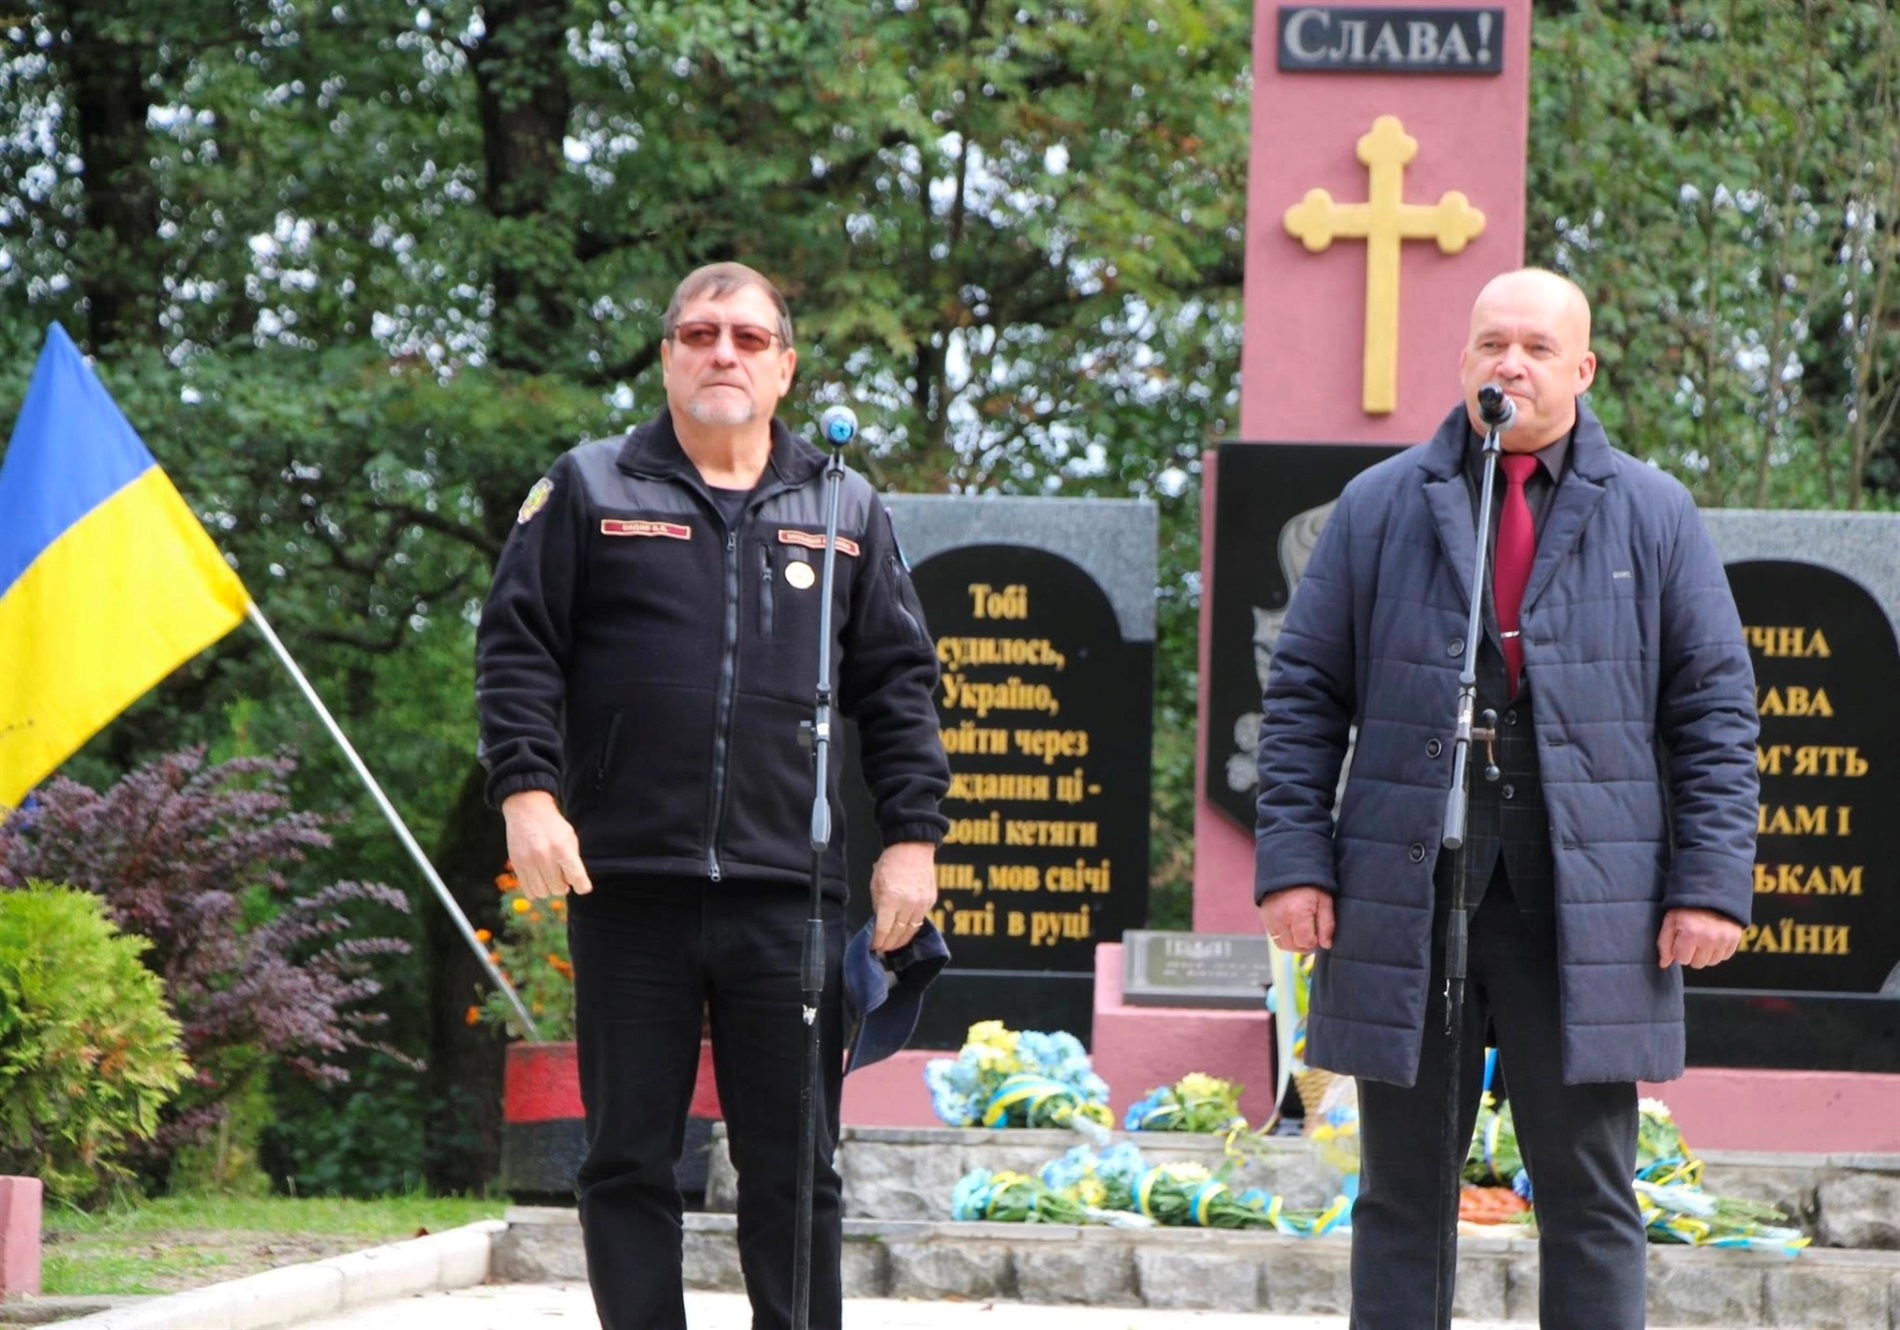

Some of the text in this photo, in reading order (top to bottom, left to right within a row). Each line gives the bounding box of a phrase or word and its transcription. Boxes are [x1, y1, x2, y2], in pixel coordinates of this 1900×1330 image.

[968, 583, 1028, 619] Тобі
[936, 637, 1066, 672] судилось,
[941, 673, 1060, 717] Україно,
[1755, 685, 1834, 717] АВА
[938, 719, 1089, 765] ойти через
[1056, 767, 1084, 804] ці
[1005, 820, 1098, 847] кетяги
[988, 865, 1041, 891] мов
[1045, 858, 1111, 893] свічі
[1007, 910, 1026, 937] в
[1030, 903, 1091, 946] руці
